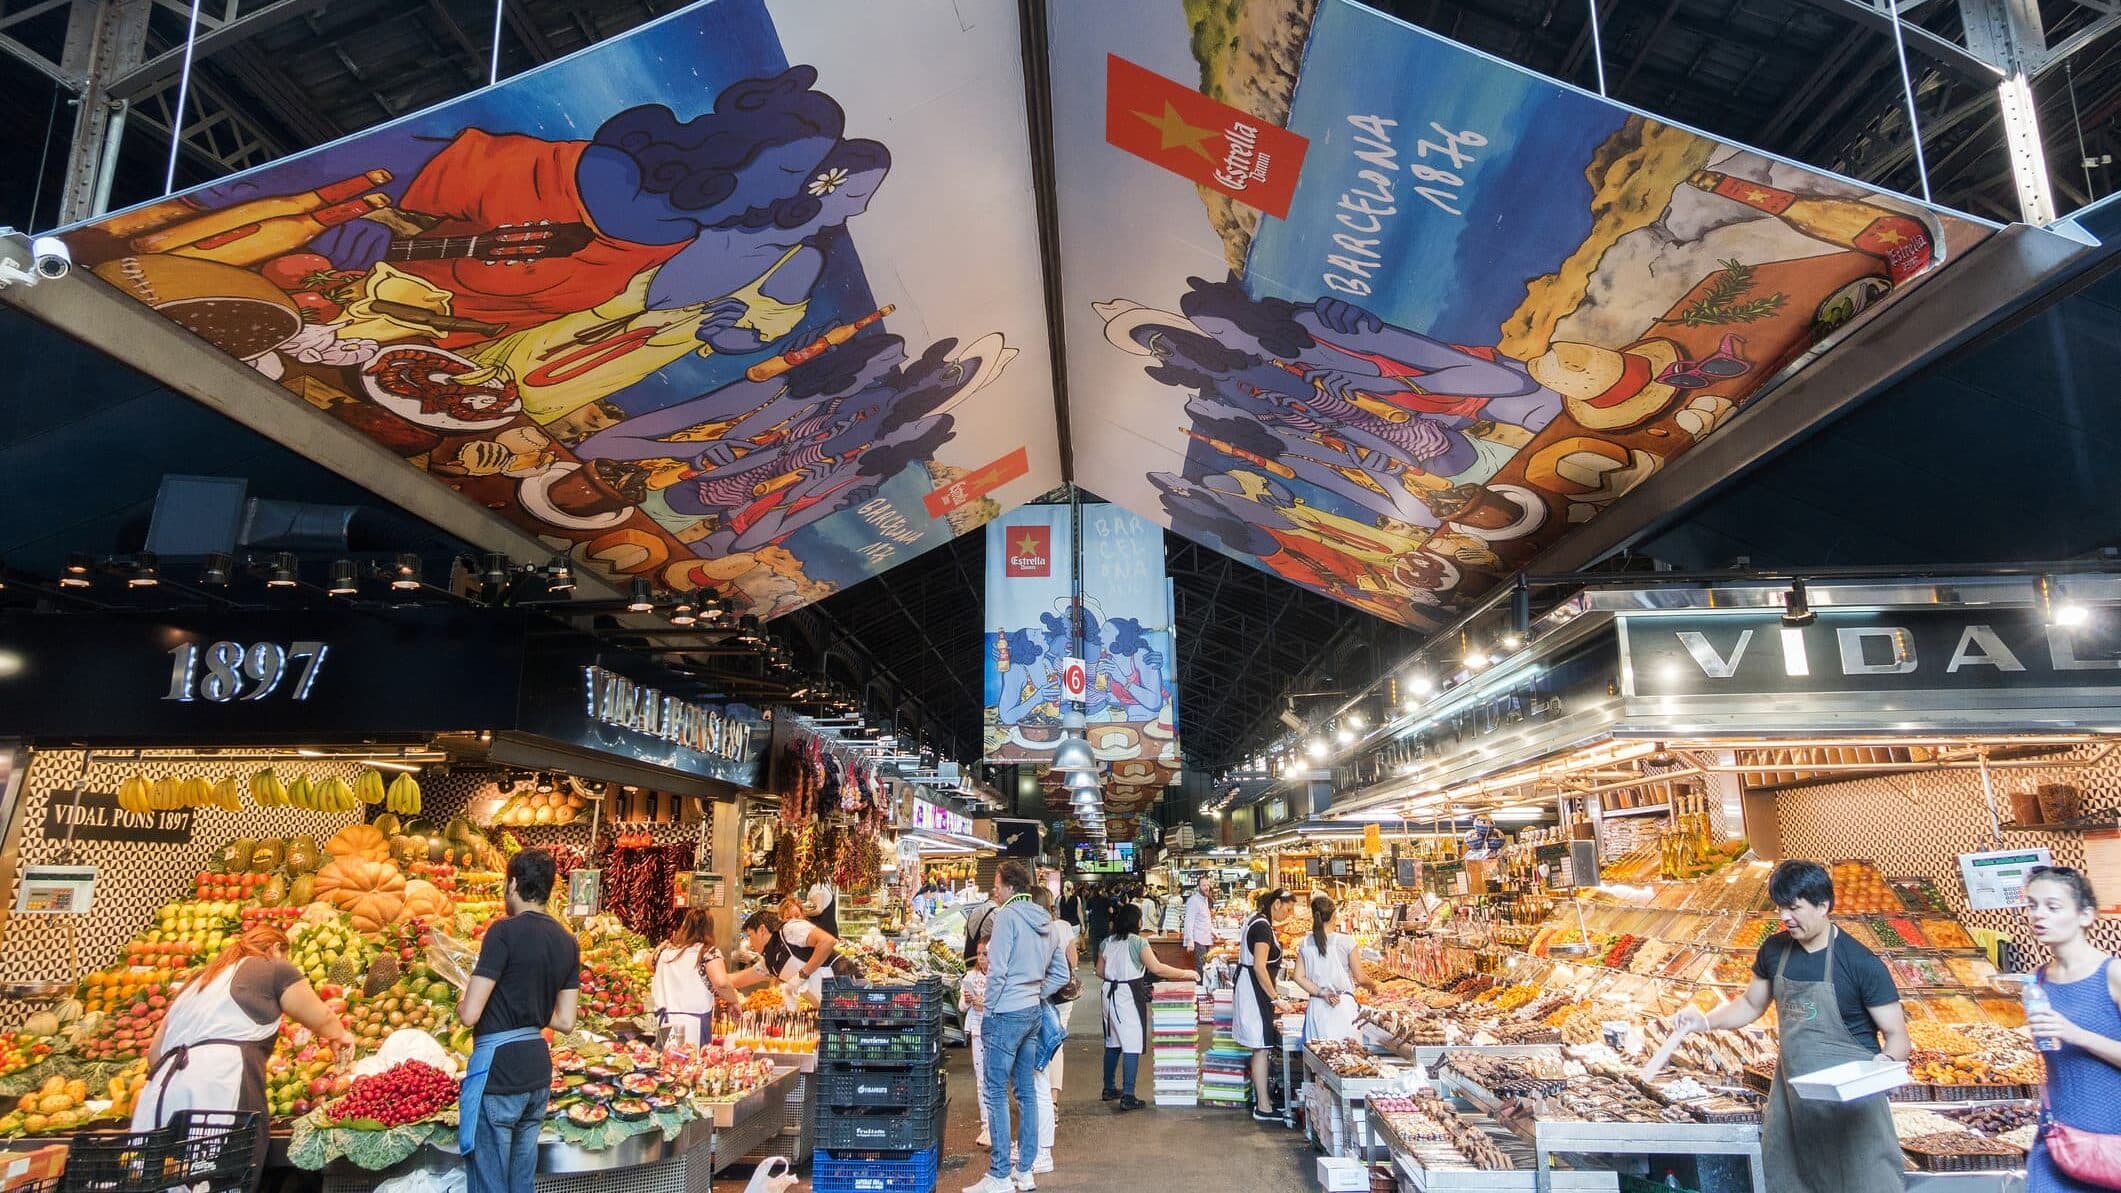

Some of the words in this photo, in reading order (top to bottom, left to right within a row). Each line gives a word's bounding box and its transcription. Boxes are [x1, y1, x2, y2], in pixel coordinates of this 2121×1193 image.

[1212, 121, 1258, 191] Estrella
[1249, 152, 1272, 183] Damm
[1410, 121, 1489, 216] 1876
[1322, 113, 1399, 297] BARCELONA
[1010, 555, 1046, 567] Estrella
[160, 641, 329, 702] 1897
[1071, 670, 1080, 689] 6
[1676, 624, 2121, 680] VIDAL
[55, 804, 108, 827] VIDAL
[112, 808, 155, 829] PONS
[158, 811, 190, 831] 1897
